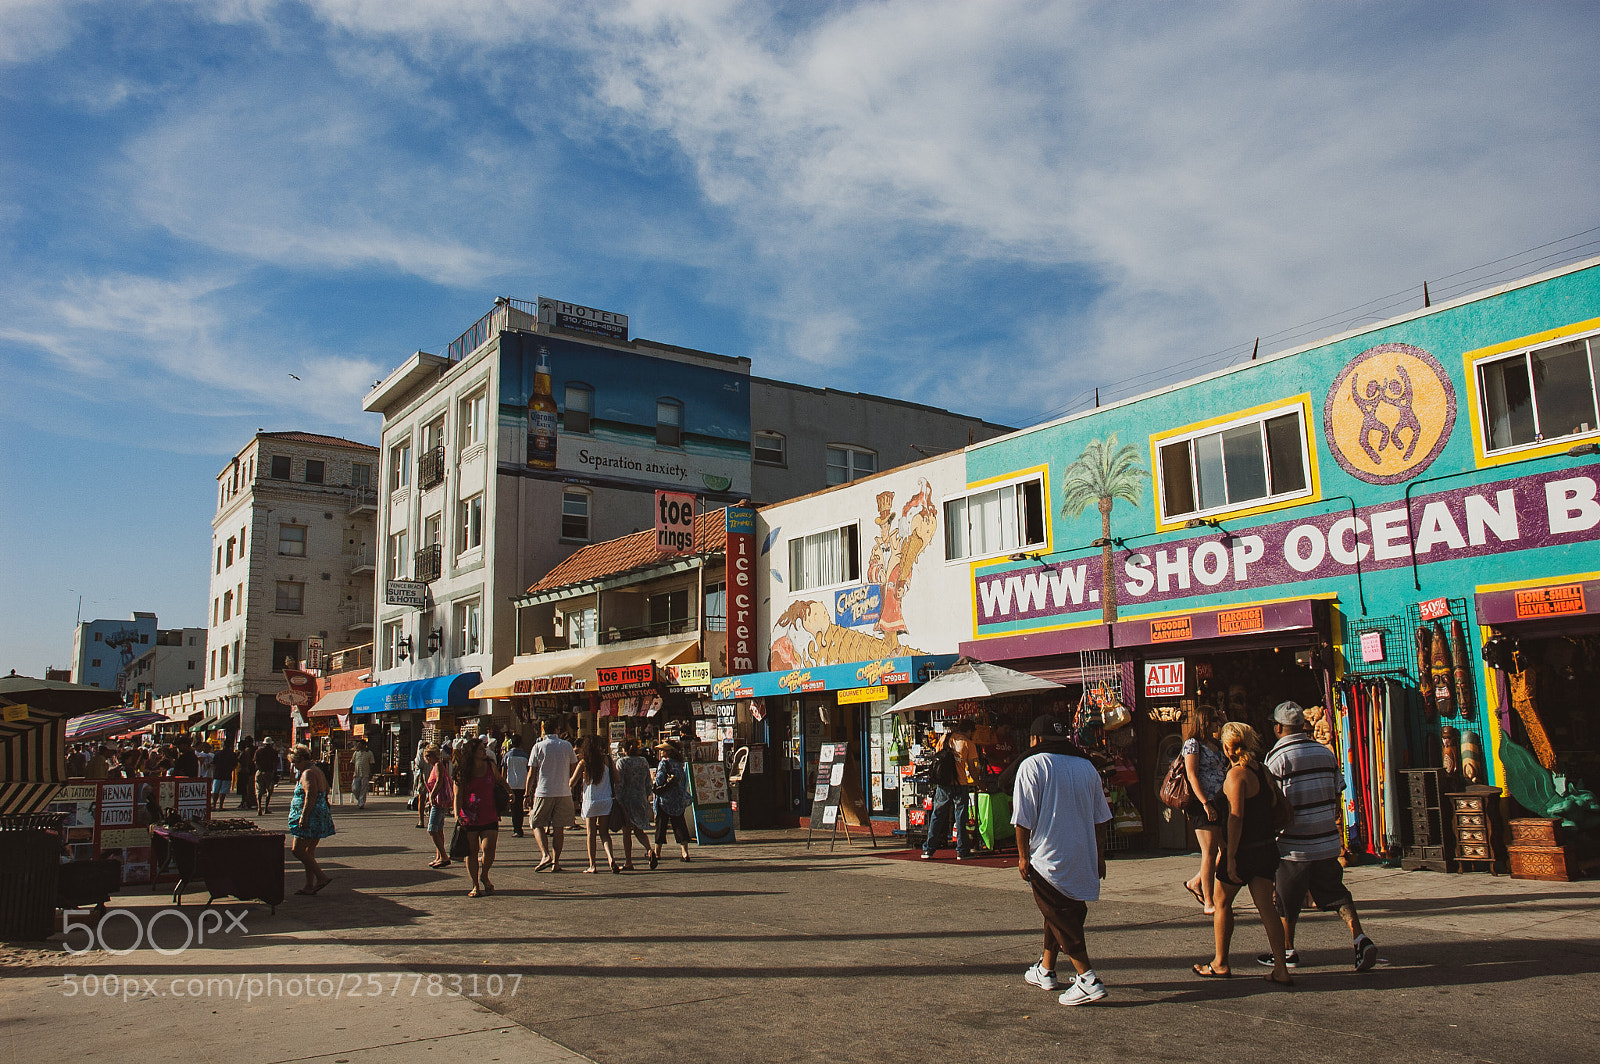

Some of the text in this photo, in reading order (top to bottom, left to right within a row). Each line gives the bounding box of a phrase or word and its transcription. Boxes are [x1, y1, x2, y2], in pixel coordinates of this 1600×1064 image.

[562, 303, 623, 326] HOTEL
[579, 450, 688, 481] Separation anxiety.
[659, 493, 693, 526] toe
[658, 525, 692, 552] rings
[979, 564, 1100, 618] WWW.
[1124, 534, 1265, 597] SHOP
[1283, 489, 1520, 573] OCEAN
[735, 537, 750, 587] ice
[388, 588, 416, 597] SUITES
[396, 596, 424, 604] HOTEL
[836, 584, 870, 616] CHARLY
[1420, 598, 1447, 616] 50%
[1220, 610, 1260, 622] SARONGS
[1431, 608, 1445, 617] OFF
[1154, 619, 1188, 631] WOODEN
[733, 594, 753, 671] cream
[1152, 628, 1190, 640] CARVINGS
[598, 668, 651, 682] toe rings
[680, 666, 709, 680] toe rings
[1147, 664, 1183, 685] ATM
[620, 681, 651, 690] JEWELRY
[839, 686, 885, 698] GOURMET COFFEE
[1150, 686, 1181, 694] INSIDE
[602, 688, 658, 700] HENNA TATTOOS
[534, 698, 555, 708] ATM
[957, 701, 978, 713] 50%
[716, 705, 735, 717] BODY
[70, 787, 95, 798] TATTOOS
[102, 786, 133, 801] HENNA
[178, 784, 206, 798] HENNA
[101, 809, 132, 824] TATTOOS
